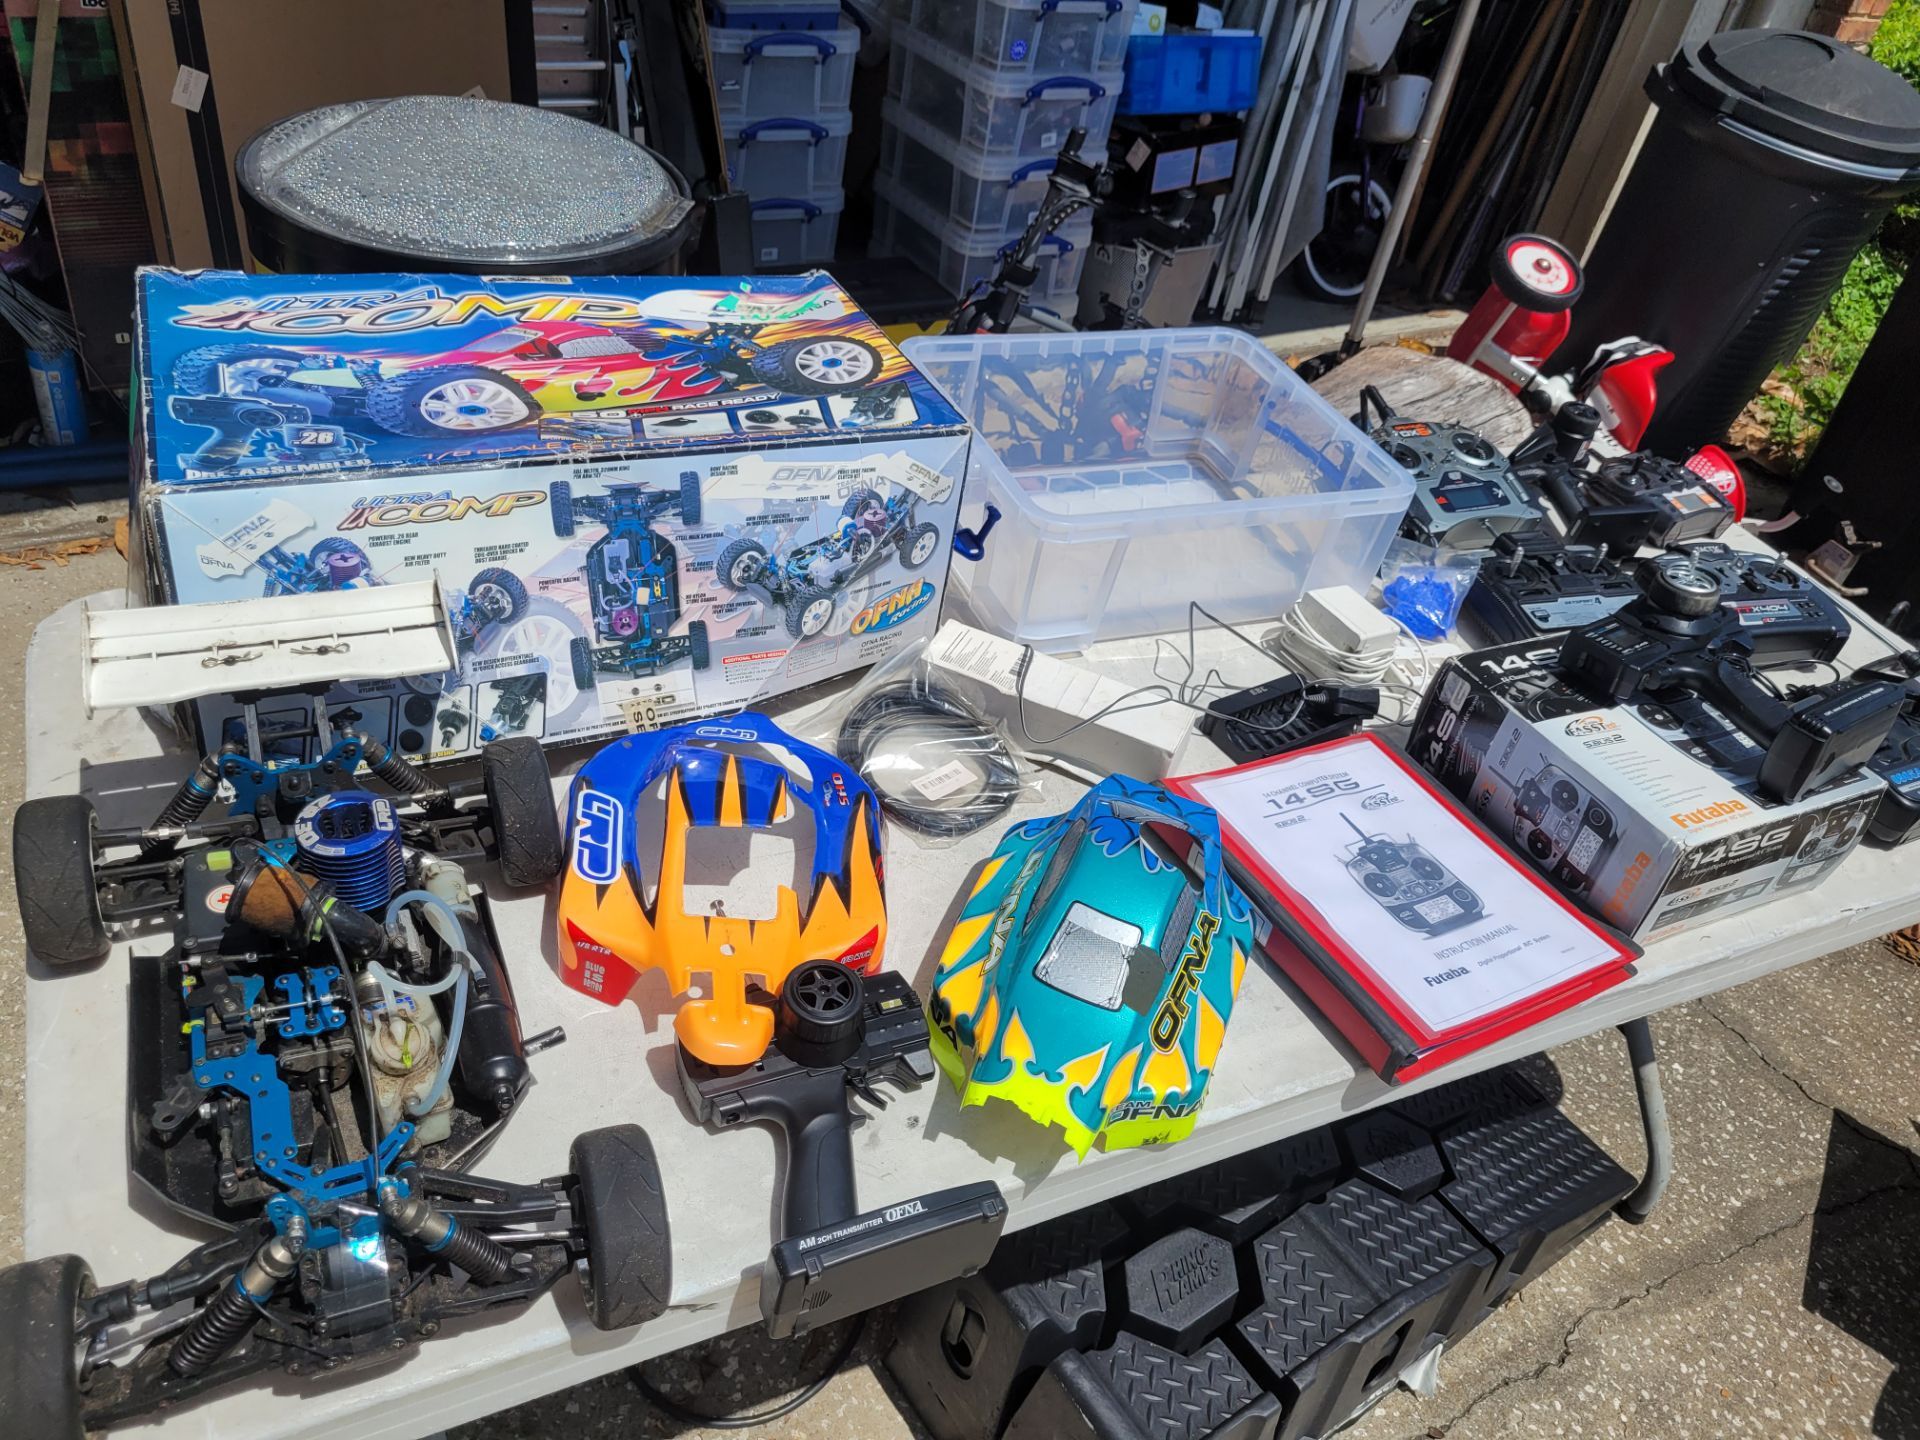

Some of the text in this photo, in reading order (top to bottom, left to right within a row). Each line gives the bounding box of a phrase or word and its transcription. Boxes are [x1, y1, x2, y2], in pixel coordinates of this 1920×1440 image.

[248, 294, 641, 335] COMP
[672, 391, 781, 411] RACE READY
[351, 489, 452, 510] ULTRA
[366, 490, 547, 527] COMP
[850, 577, 924, 635] OFNA
[889, 591, 932, 625] Racing
[861, 638, 878, 648] OFNA
[879, 631, 903, 642] RACING
[472, 659, 483, 667] NEW
[483, 657, 500, 665] DESIGN
[724, 655, 751, 663] ADDITIONAL
[1480, 648, 1560, 674] 14S
[1266, 777, 1361, 810] 14SG
[1270, 784, 1298, 797] CHANNEL
[1298, 775, 1328, 789] COMPUTER
[372, 798, 395, 831] LRP
[1670, 799, 1748, 830] Futaba
[1689, 824, 1795, 870] 14SG
[1433, 923, 1519, 961] INSTRUCTION MANUAL
[1423, 965, 1471, 988] Futaba
[1477, 957, 1493, 967] Digital
[1493, 945, 1523, 961] Proportional
[1534, 933, 1551, 944] System
[1148, 909, 1222, 1056] OFNA
[799, 1199, 929, 1251] AM 2CH TRANSMITTER OFNA
